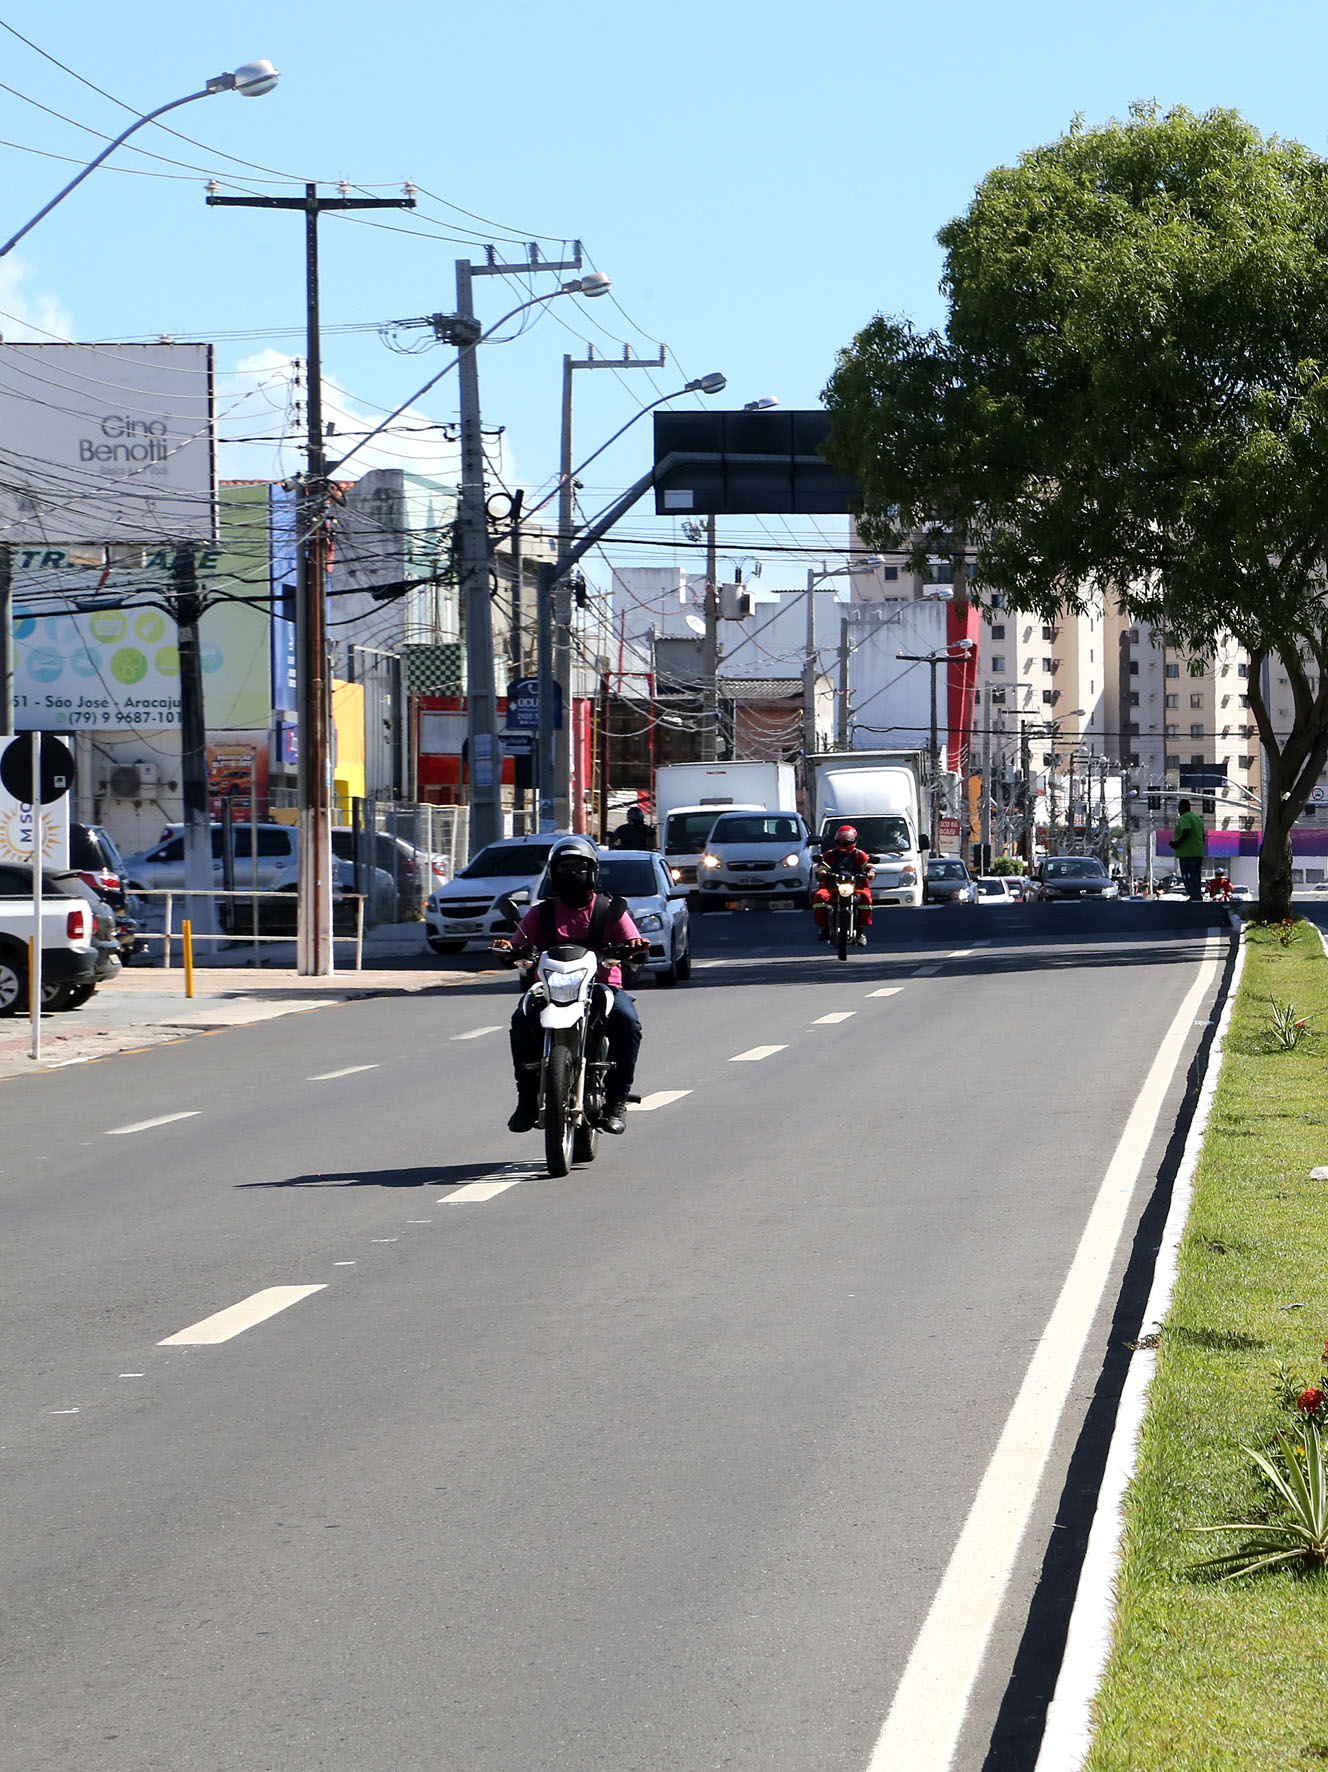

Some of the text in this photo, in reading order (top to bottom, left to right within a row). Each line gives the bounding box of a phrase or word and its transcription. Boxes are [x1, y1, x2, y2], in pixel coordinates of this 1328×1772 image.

[101, 415, 167, 438] Gino
[45, 694, 72, 708] São
[77, 695, 109, 708] José
[69, 711, 97, 725] (79)
